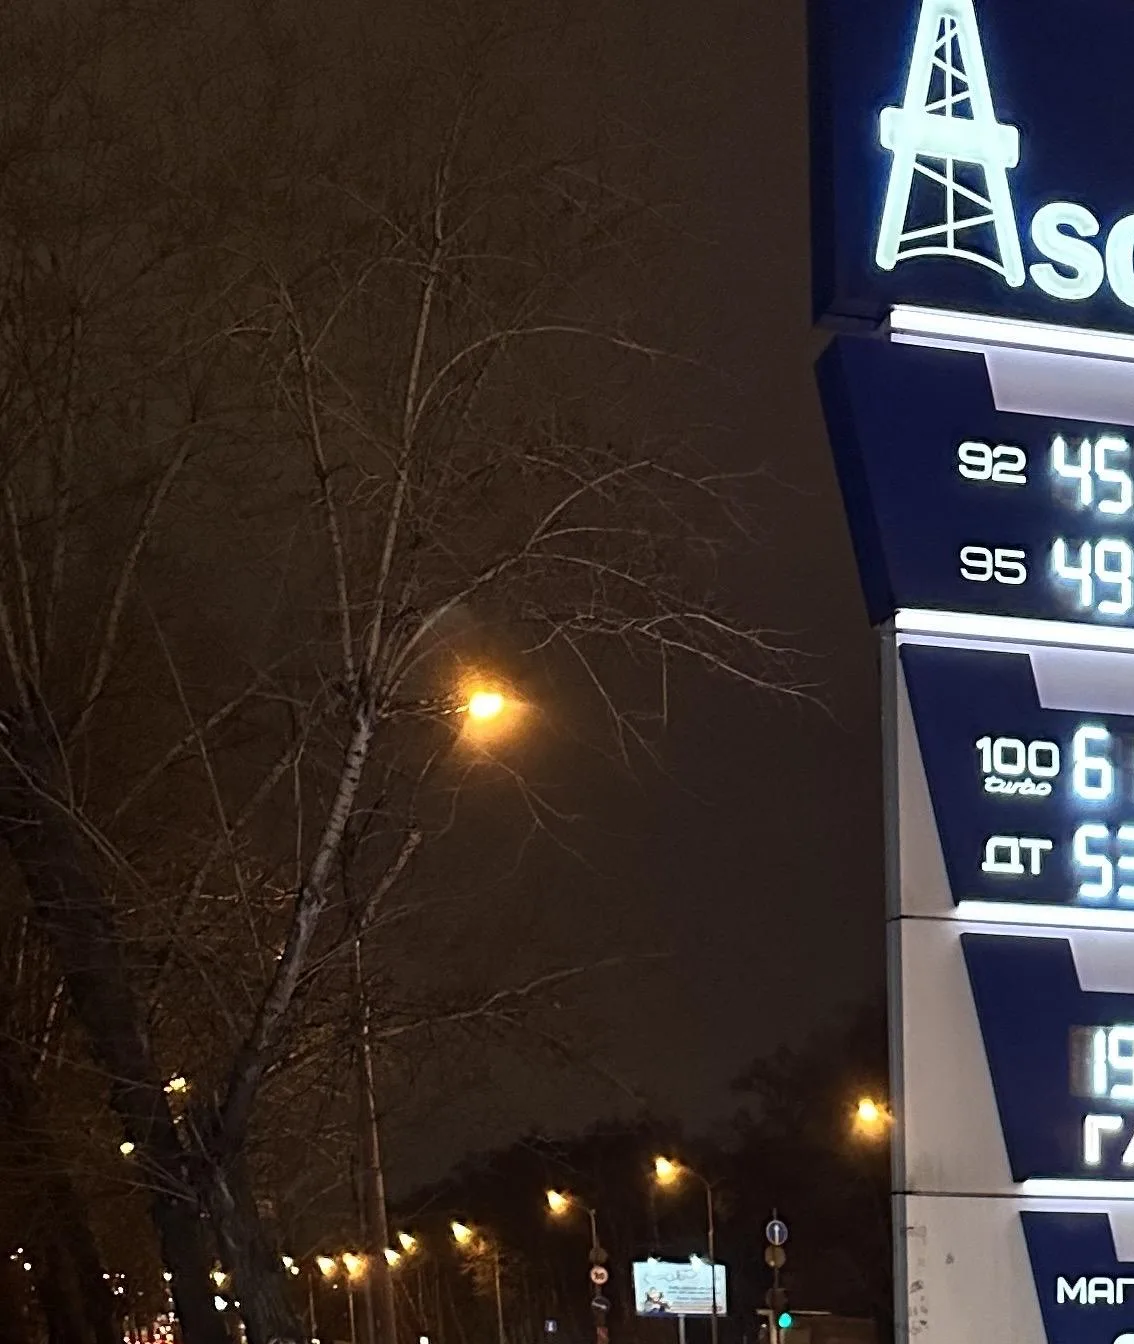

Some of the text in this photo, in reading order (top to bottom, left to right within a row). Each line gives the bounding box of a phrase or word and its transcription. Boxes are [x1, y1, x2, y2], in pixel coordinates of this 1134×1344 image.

[958, 442, 1027, 484] 92
[960, 546, 1027, 585] 95
[976, 736, 1060, 776] 100
[984, 776, 1052, 796] turbo
[981, 836, 1053, 875] ДТ
